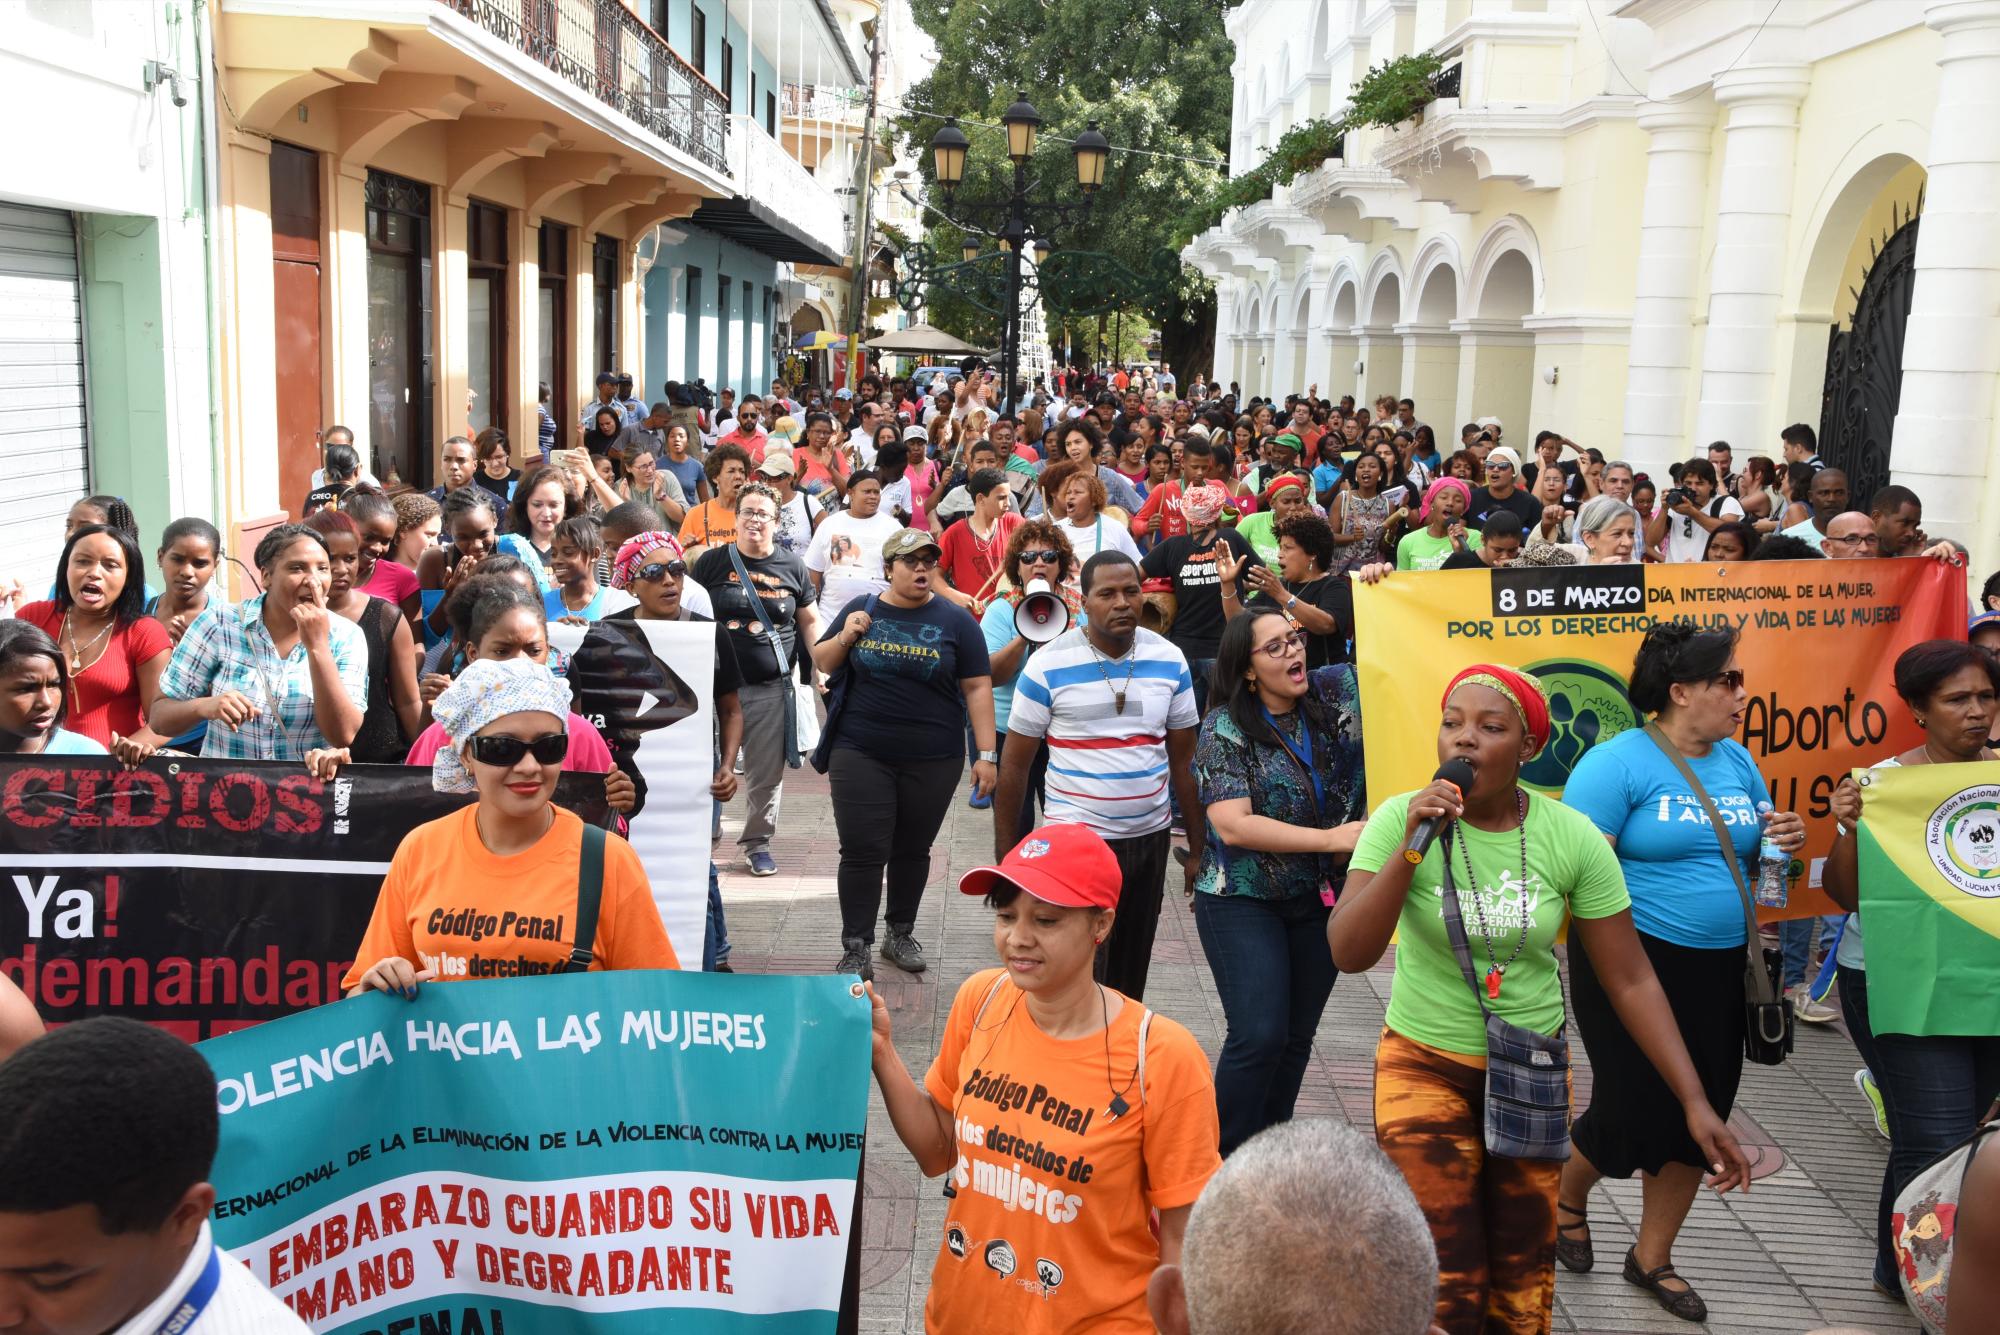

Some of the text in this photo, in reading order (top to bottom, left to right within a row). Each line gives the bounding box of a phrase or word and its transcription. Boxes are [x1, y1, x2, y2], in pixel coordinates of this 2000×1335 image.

[1448, 620, 1493, 640] POR
[1505, 618, 1541, 637] LOS
[1736, 613, 1749, 631] Y
[1754, 608, 1791, 631] VIDA
[1796, 610, 1816, 627] DE
[1823, 607, 1845, 628] LAS
[1499, 582, 1876, 612] 8 DE MARZO DÍA INTERNACIONAL DE LA MUJER.
[1742, 687, 1888, 757] Aborto
[1930, 789, 2000, 845] Asociación Nacional
[12, 875, 120, 938] Ya!
[427, 907, 563, 942] Código Penal
[440, 951, 467, 977] los
[469, 953, 549, 978] derechos
[406, 1019, 522, 1061] HACIA
[537, 1011, 600, 1054] LAS
[620, 1010, 766, 1054] MUJERES
[963, 1069, 1095, 1136] Código Penal
[347, 1143, 371, 1168] DE
[380, 1133, 406, 1154] LA
[413, 1126, 529, 1152] ELIMINACIÓN
[539, 1131, 566, 1151] DE
[576, 1128, 602, 1148] LA
[607, 1120, 704, 1145] VIOLENCIA
[709, 1126, 771, 1152] CONTRA
[776, 1134, 800, 1154] LA
[962, 1115, 984, 1146] los
[986, 1125, 1067, 1179] derechos
[1067, 1156, 1094, 1184] de
[972, 1158, 1083, 1224] mujeres
[269, 1183, 840, 1289] EMBARAZO CUANDO SU VIDA
[433, 1239, 460, 1279] Y
[475, 1243, 734, 1297] DEGRADANTE
